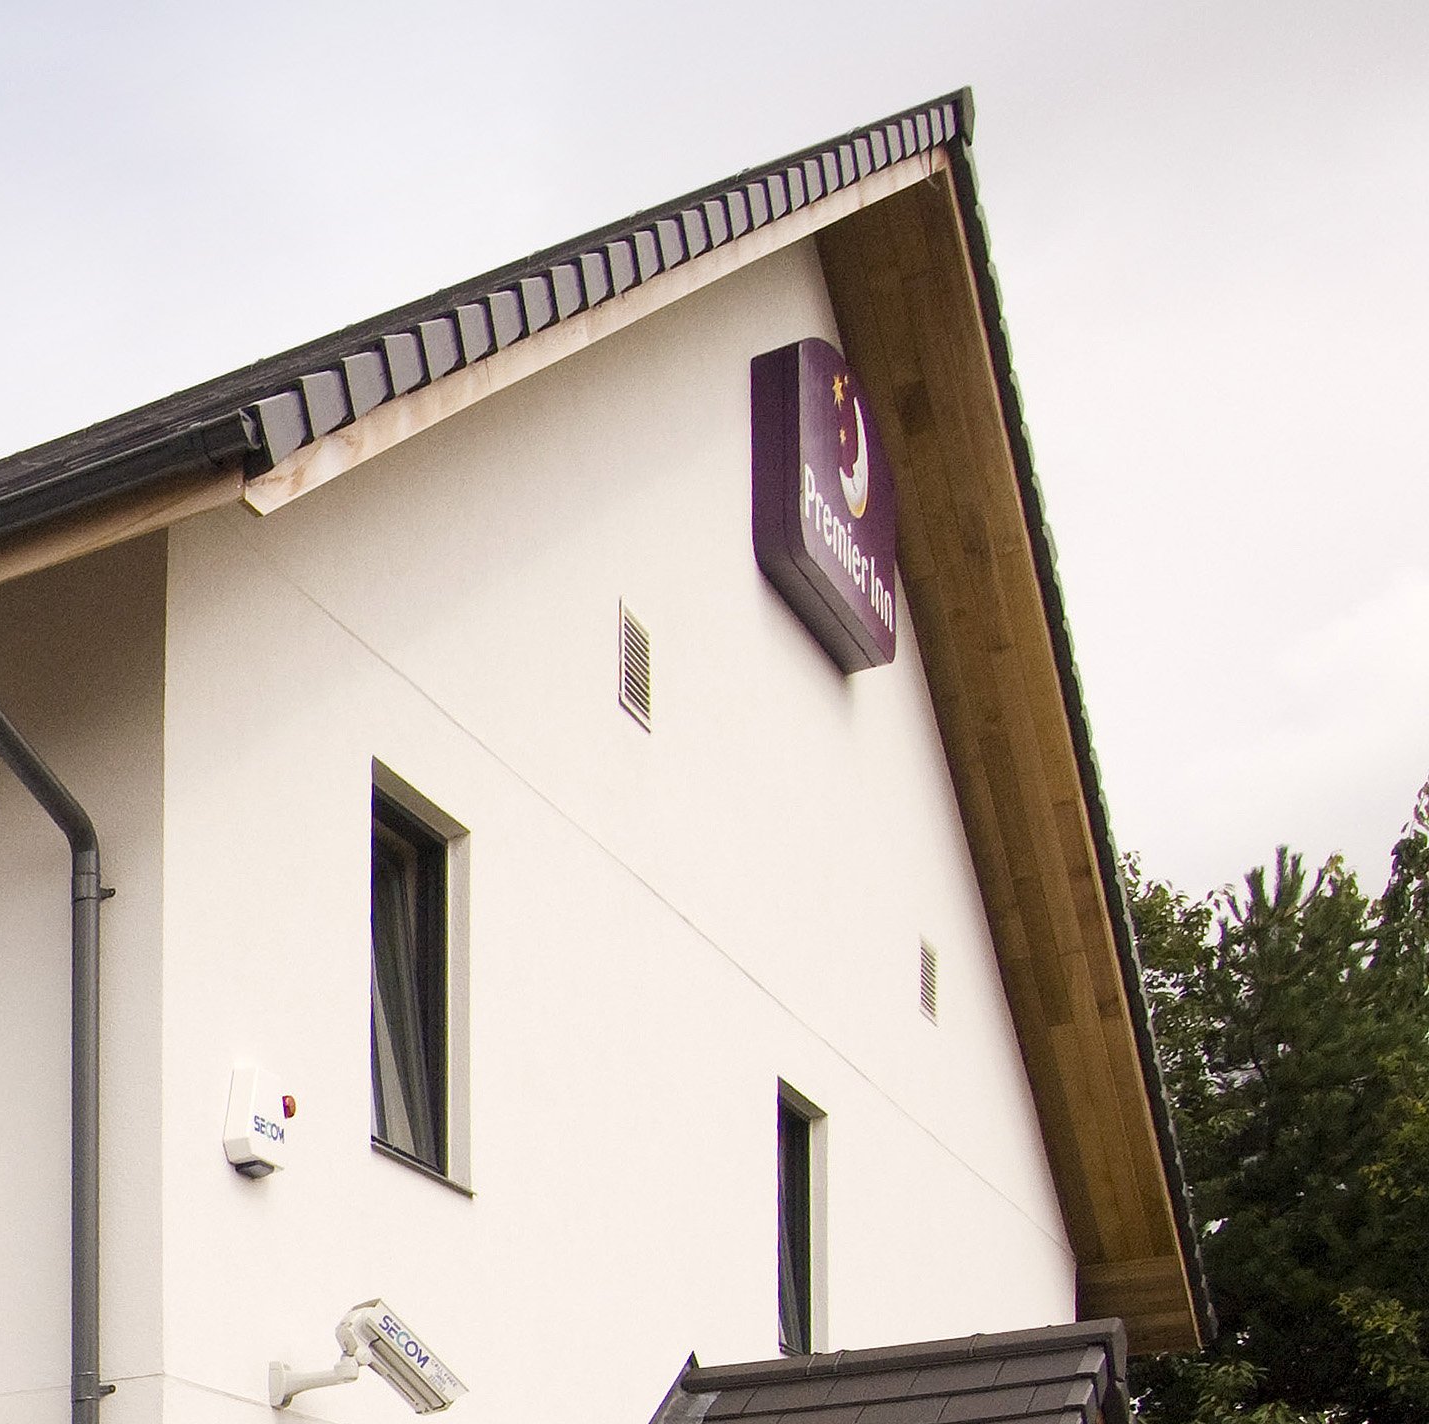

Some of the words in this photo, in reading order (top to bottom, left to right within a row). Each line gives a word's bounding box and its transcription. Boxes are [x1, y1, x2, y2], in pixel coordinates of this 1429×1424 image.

[804, 463, 871, 595] Premier
[870, 556, 894, 633] Inn
[253, 1114, 285, 1144] SECOM
[379, 1314, 430, 1369] SECOM
